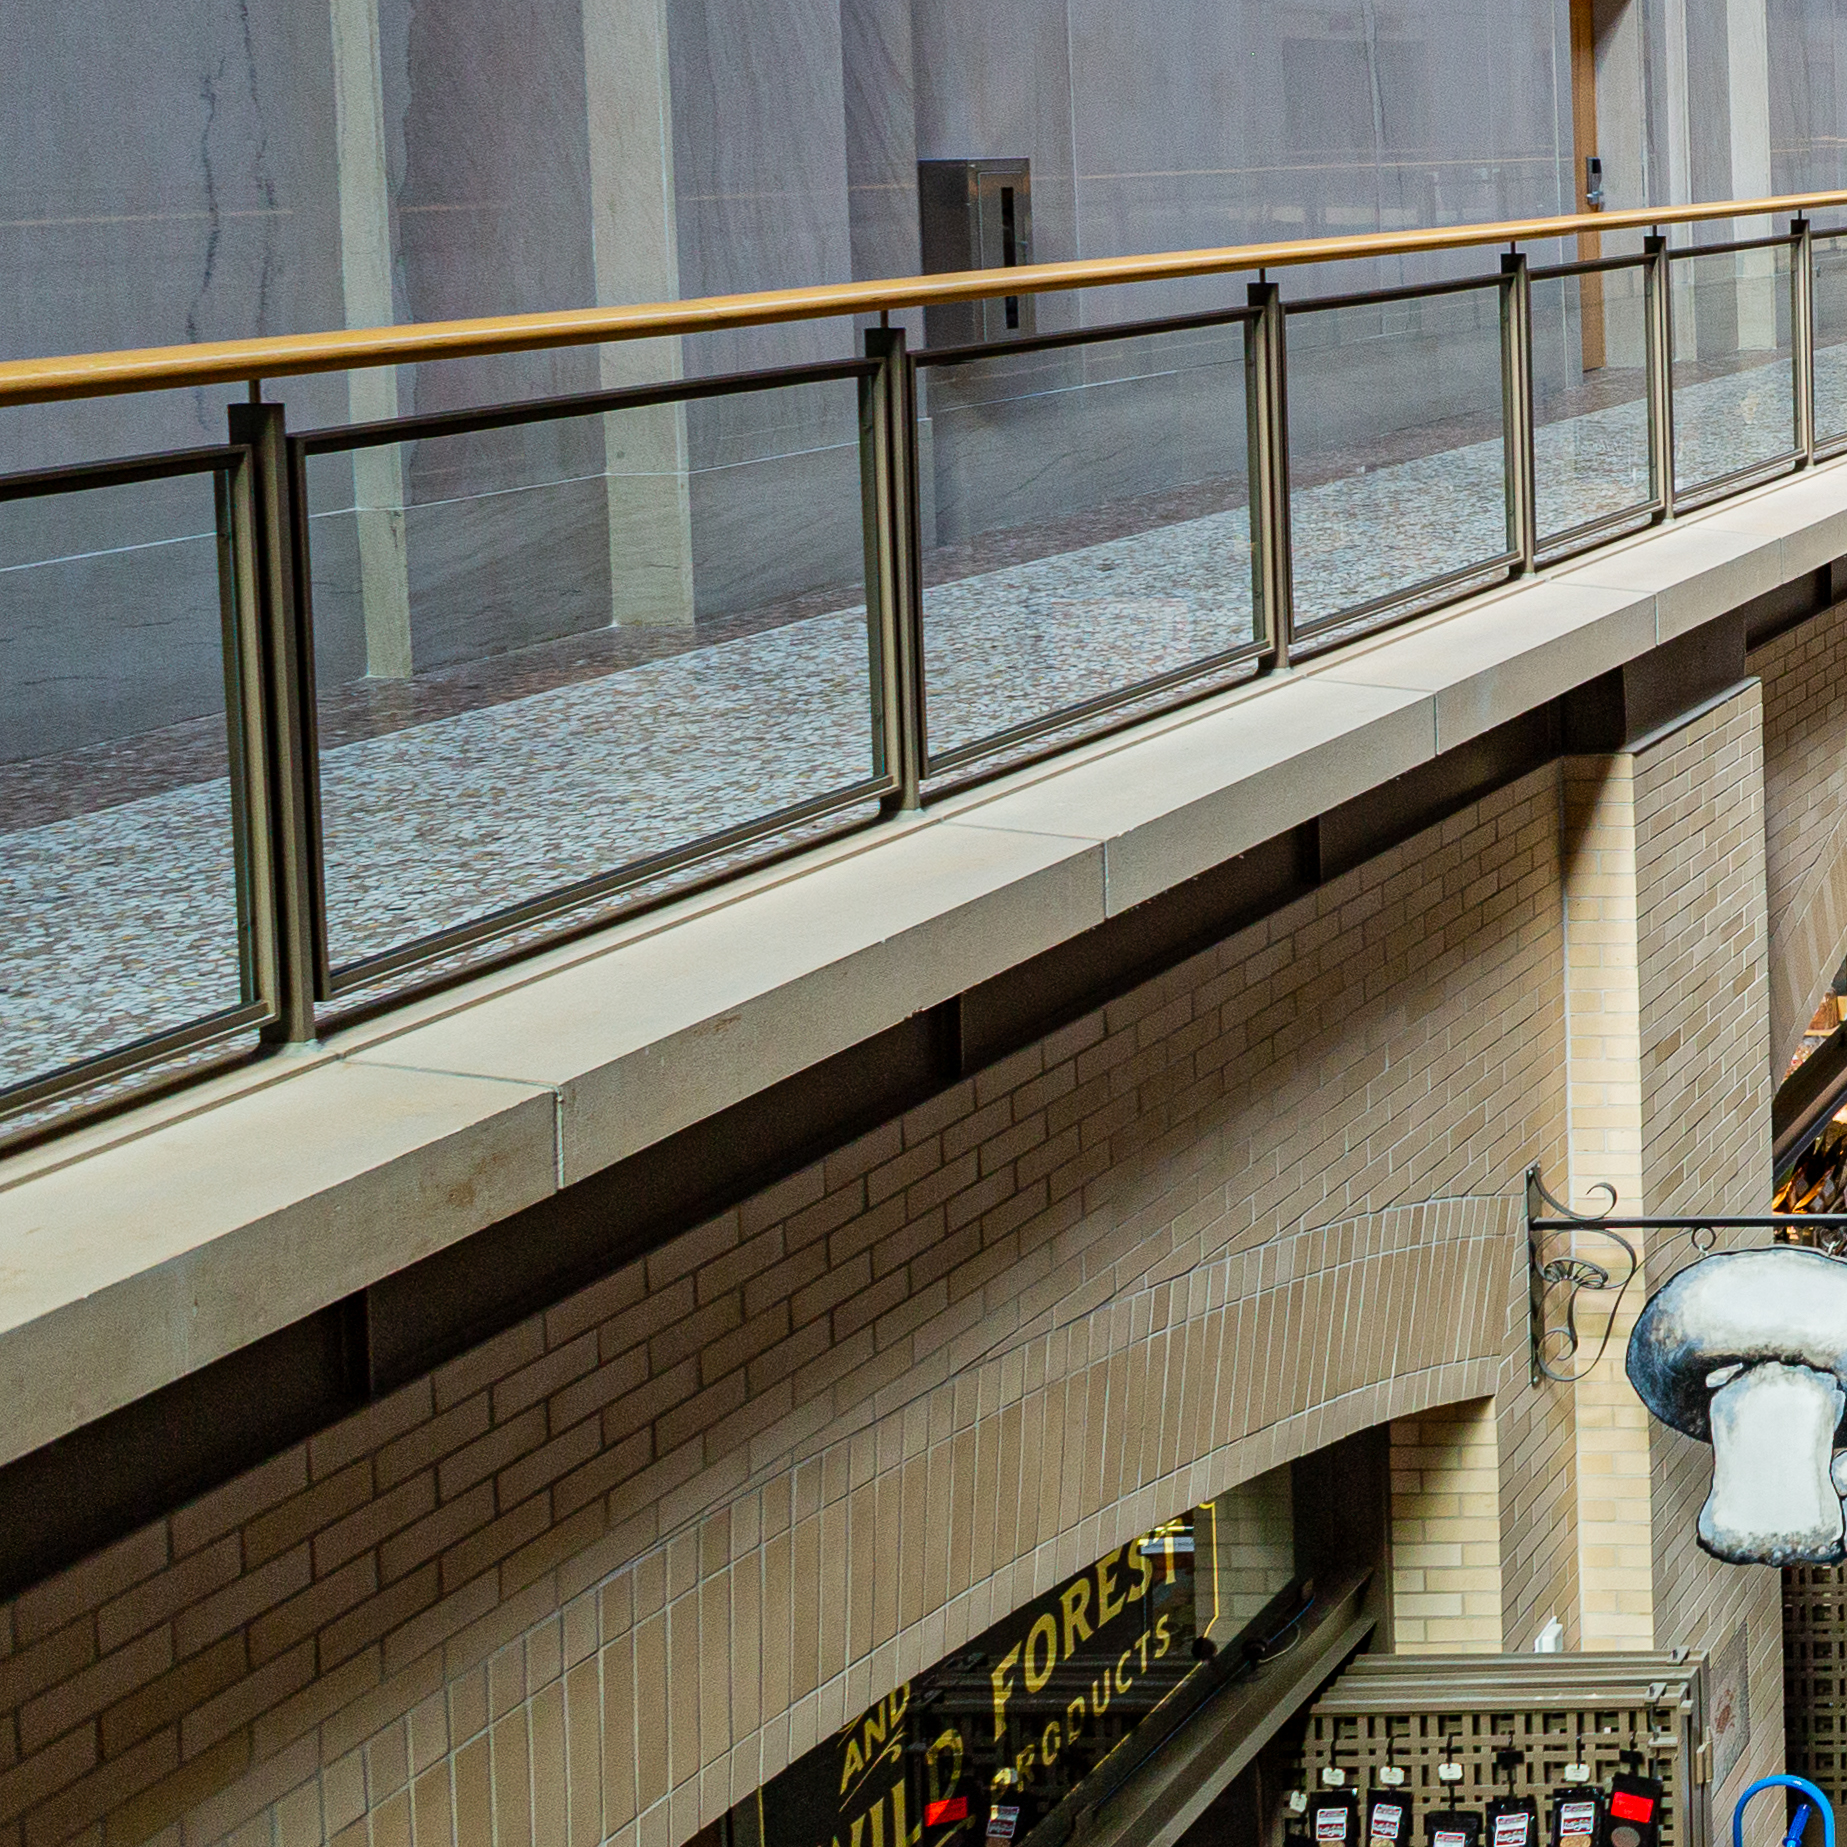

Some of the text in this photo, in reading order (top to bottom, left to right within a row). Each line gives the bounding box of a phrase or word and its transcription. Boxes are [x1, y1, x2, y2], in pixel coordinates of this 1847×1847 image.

[991, 1517, 1183, 1742] FOREST
[991, 1613, 1171, 1819] PRODUCTS
[840, 1682, 910, 1795] AND
